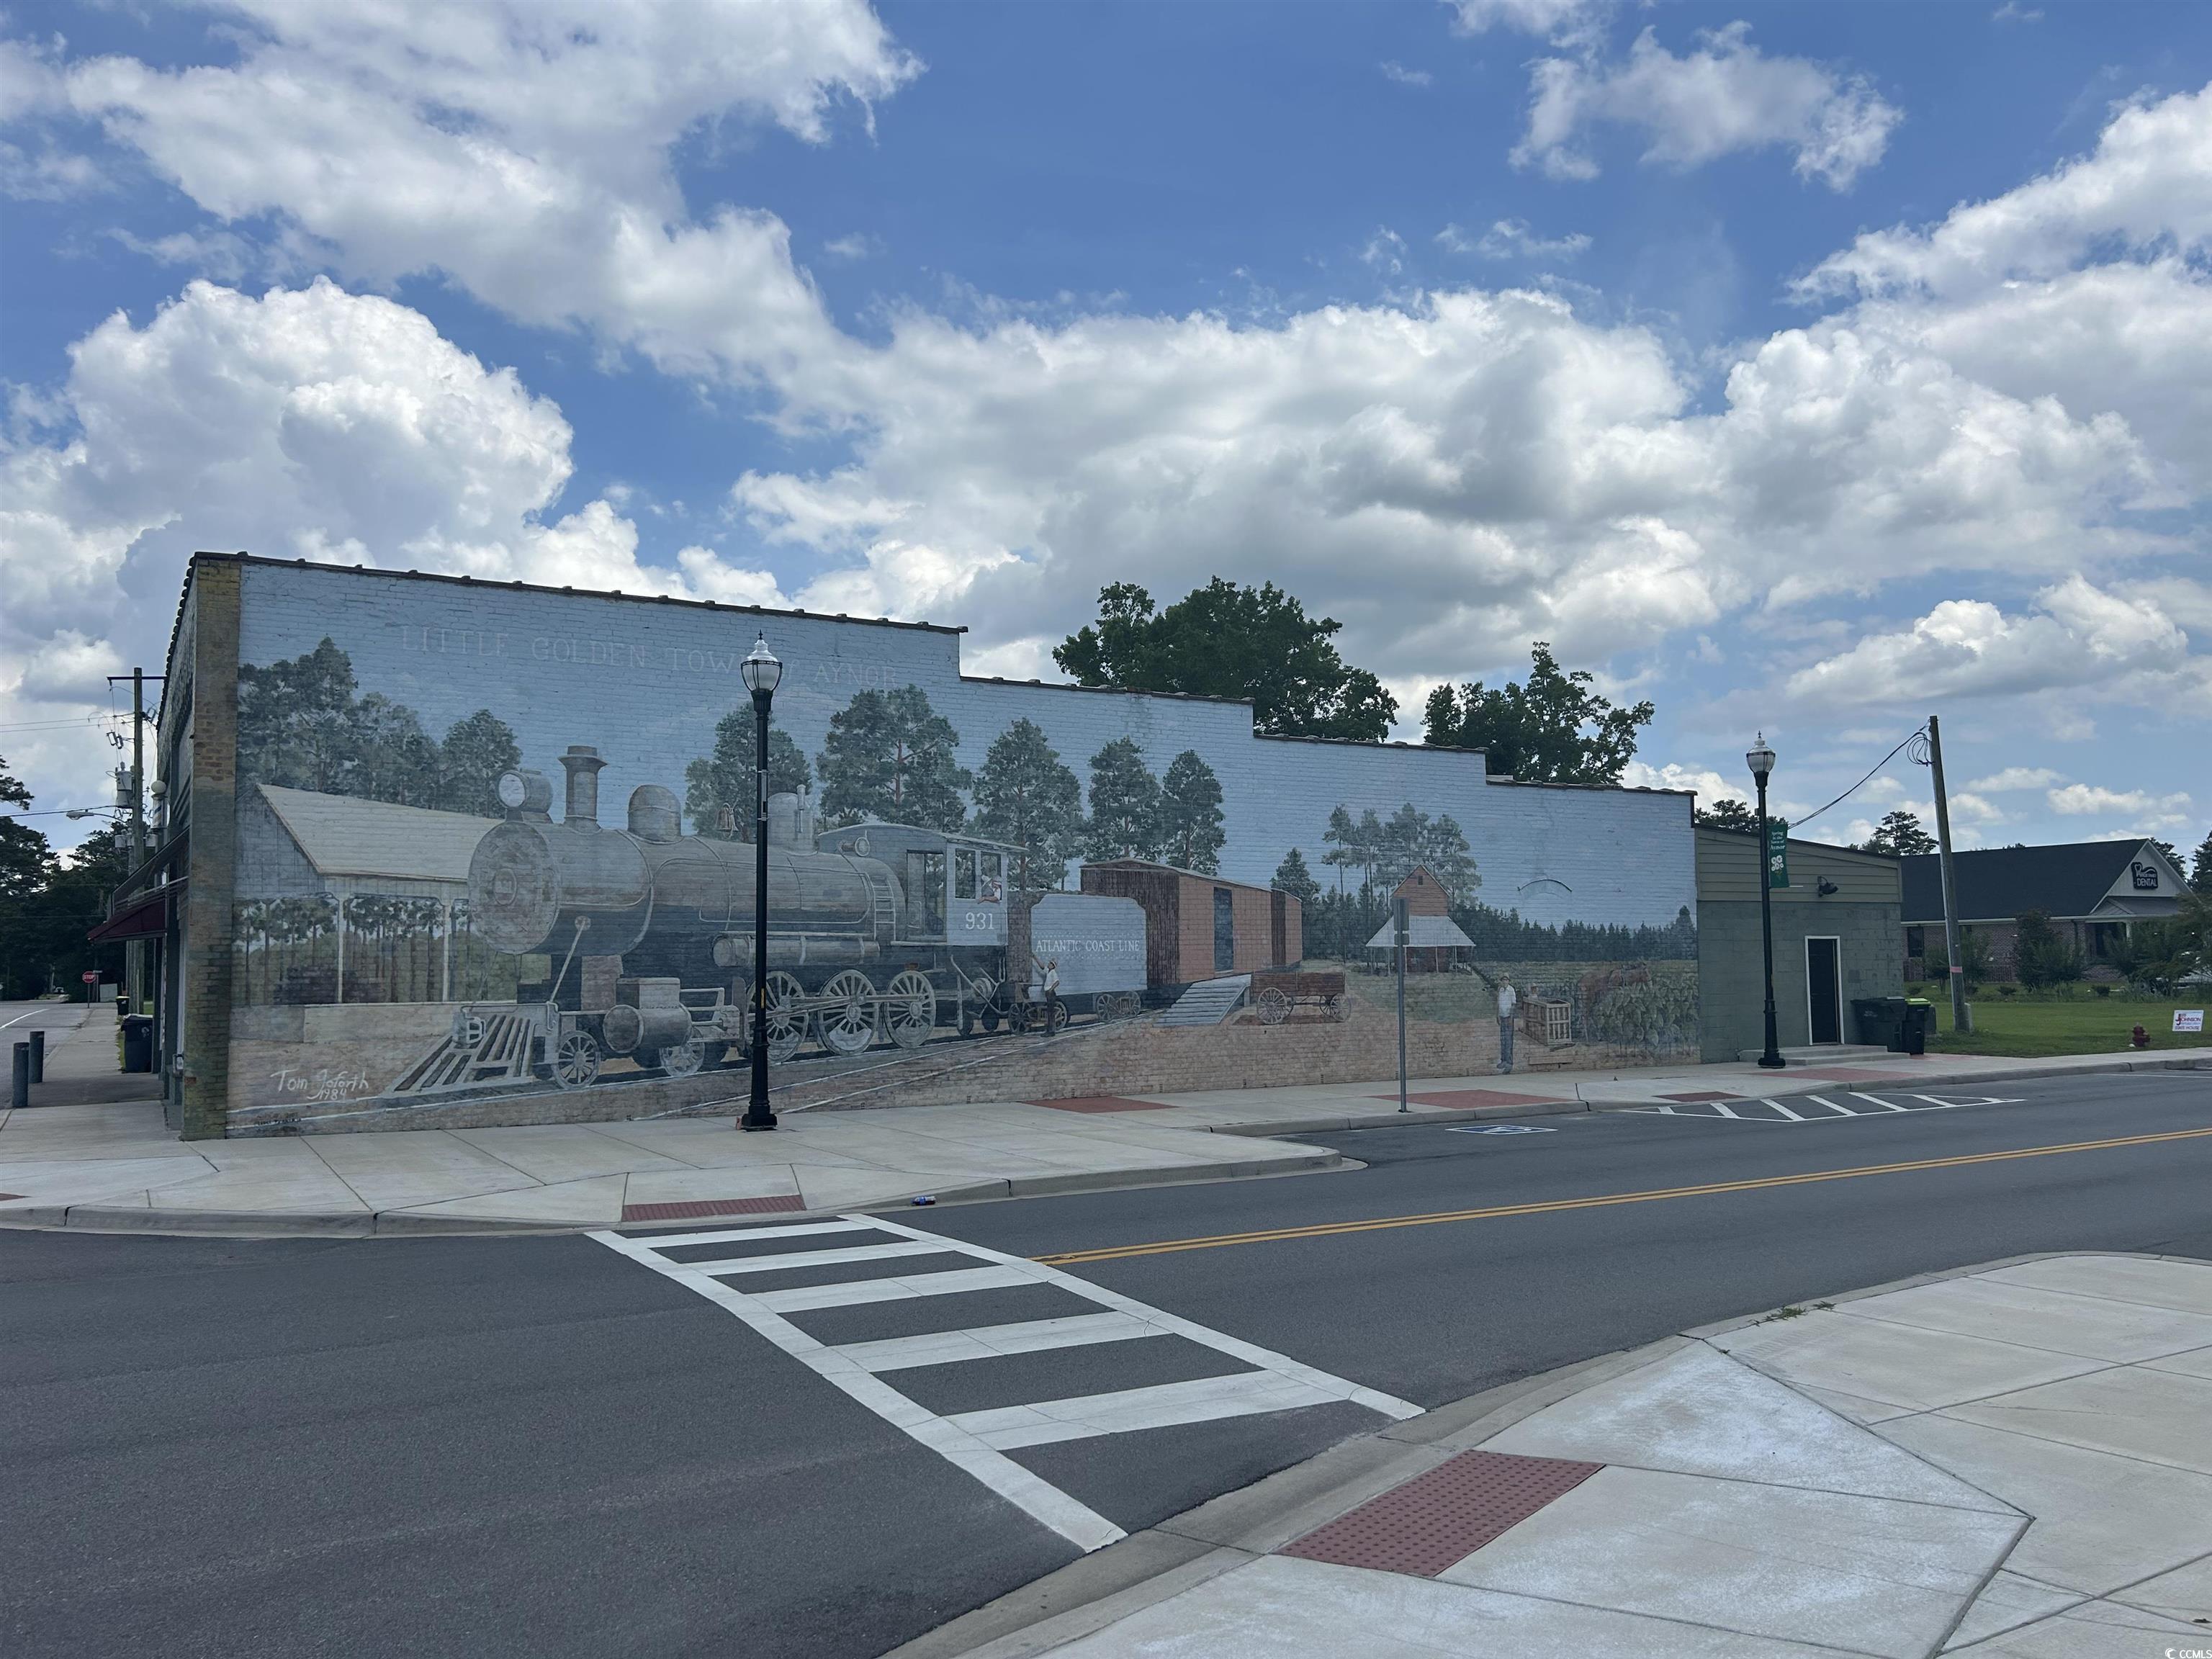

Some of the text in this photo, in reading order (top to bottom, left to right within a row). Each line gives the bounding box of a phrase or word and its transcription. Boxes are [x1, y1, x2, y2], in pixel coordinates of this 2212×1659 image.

[403, 625, 508, 657] LITTLE
[531, 637, 646, 669] GOLDEN
[666, 647, 746, 675] TOW
[812, 662, 898, 687] AYNOR
[2137, 878, 2157, 886] DENTAL
[965, 912, 994, 930] 931
[1035, 940, 1140, 952] ATLANTIC COAST LINE
[270, 1069, 307, 1092] Tom
[319, 1088, 347, 1100] 1984
